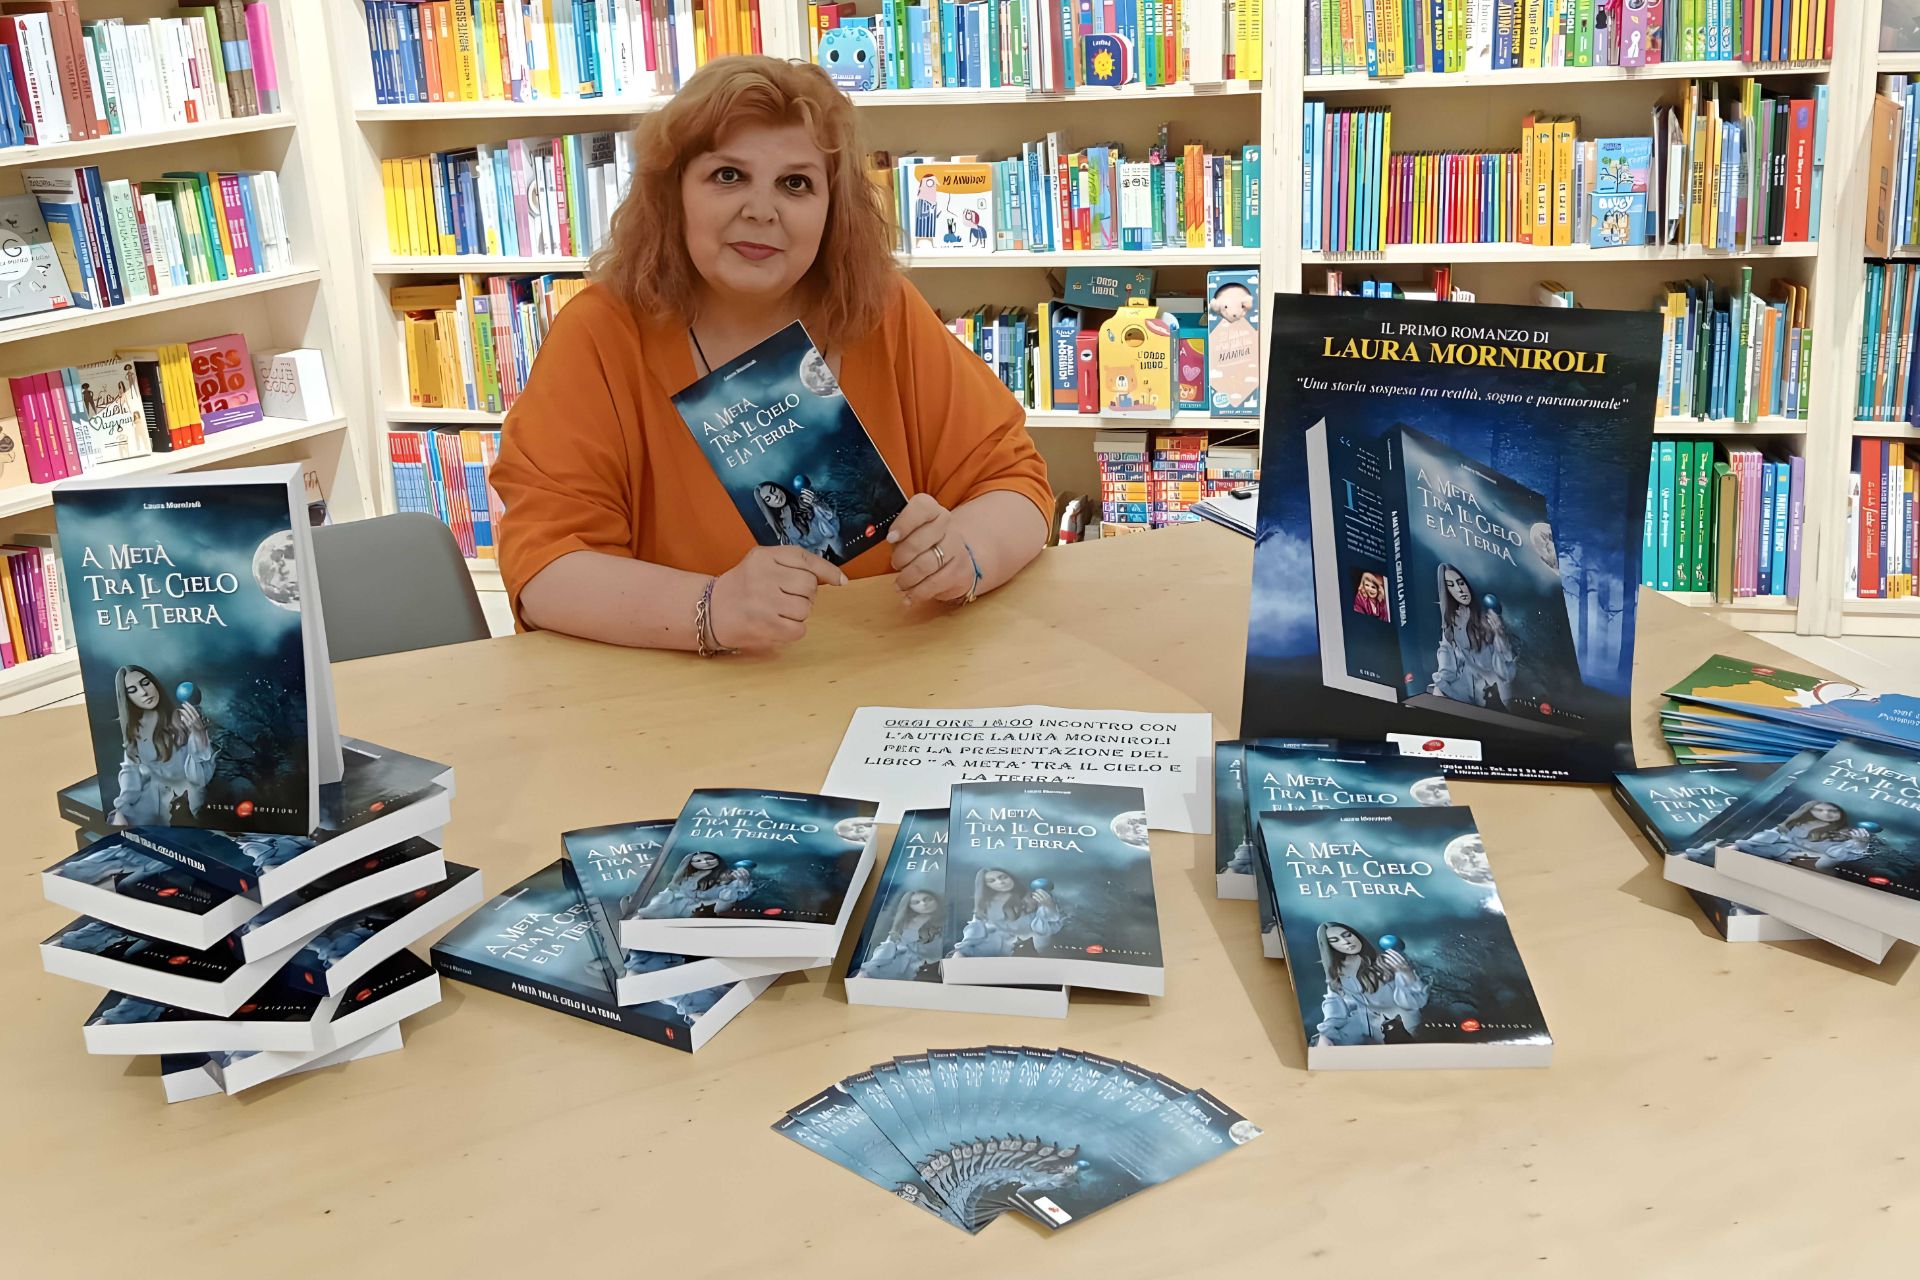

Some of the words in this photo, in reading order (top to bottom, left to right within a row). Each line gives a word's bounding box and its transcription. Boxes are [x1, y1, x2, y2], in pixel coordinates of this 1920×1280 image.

[1381, 322, 1395, 335] IL
[1399, 323, 1447, 338] PRIMO
[1451, 326, 1529, 342] ROMANZO
[1533, 331, 1550, 343] DI
[1322, 336, 1420, 362] LAURA
[1428, 343, 1608, 374] MORNIROLI
[1331, 380, 1367, 393] storia
[1370, 384, 1417, 397] sospesa
[1420, 387, 1438, 397] tra
[1485, 391, 1523, 405] sogno
[1526, 395, 1534, 404] e
[703, 421, 719, 436] A
[710, 430, 742, 454] TRA
[739, 420, 757, 438] IL
[756, 393, 800, 428] CIELO
[726, 455, 738, 468] E
[734, 446, 753, 466] LA
[750, 418, 805, 454] TERRA
[1417, 467, 1432, 488] A
[1475, 515, 1523, 547] CIELO
[1460, 525, 1518, 567] TERRA
[81, 547, 103, 568] A
[84, 574, 134, 601] TRA
[139, 573, 161, 599] IL
[165, 572, 239, 599] CIELO
[98, 608, 112, 626] E
[115, 605, 138, 631] LA
[143, 603, 228, 630] TERRA
[1039, 719, 1134, 731] INCONTRO
[1136, 723, 1178, 732] CON
[885, 731, 985, 741] L'AUTRICE
[990, 732, 1058, 741] LAURA
[1065, 733, 1172, 745] MORNIROLI
[883, 744, 921, 753] PER
[926, 746, 952, 754] LA
[960, 746, 1125, 757] PRESENTAZIONE
[1130, 750, 1169, 759] DEL
[864, 757, 922, 766] LIBRO
[942, 759, 957, 767] A
[1031, 761, 1072, 770] TRA
[1079, 762, 1099, 771] IL
[1103, 763, 1163, 772] CIELO
[1170, 764, 1183, 773] E
[1836, 758, 1854, 769] A
[962, 773, 988, 781] LA
[1263, 772, 1281, 785] A
[1829, 765, 1870, 784] TRA
[1874, 779, 1896, 790] IL
[1263, 786, 1306, 801] TRA
[1310, 789, 1329, 803] IL
[1333, 791, 1398, 805] CIELO
[1650, 785, 1667, 799] A
[1822, 778, 1837, 786] E
[1836, 781, 1859, 792] LA
[1868, 788, 1920, 812] TERR
[696, 807, 712, 816] A
[1652, 800, 1696, 813] TRA
[1700, 798, 1723, 810] IL
[966, 808, 981, 820] A
[692, 817, 729, 828] TRA
[734, 818, 752, 828] IL
[756, 820, 820, 834] CIELO
[965, 822, 1005, 836] TRA
[1011, 822, 1029, 835] IL
[1034, 822, 1097, 837] CIELO
[730, 829, 799, 844] TERRA
[909, 832, 923, 844] A
[971, 838, 981, 847] E
[986, 836, 1006, 849] LA
[1010, 836, 1085, 853] TERRA
[588, 849, 605, 860] A
[906, 845, 944, 858] TRA
[1285, 843, 1300, 858] A
[589, 857, 632, 872] TRA
[638, 853, 655, 866] IL
[907, 861, 917, 870] E
[920, 859, 940, 873] LA
[1287, 861, 1332, 879] TRA
[1338, 861, 1359, 878] IL
[1363, 860, 1433, 879] CIELO
[600, 871, 614, 882] E
[1299, 883, 1312, 896] E
[1315, 880, 1339, 899] LA
[1342, 881, 1425, 899] TERRA
[501, 937, 544, 960] TRA
[534, 926, 558, 937] IL
[552, 903, 589, 924] CIE
[485, 944, 509, 955] A
[531, 955, 548, 965] E
[540, 944, 565, 957] LA
